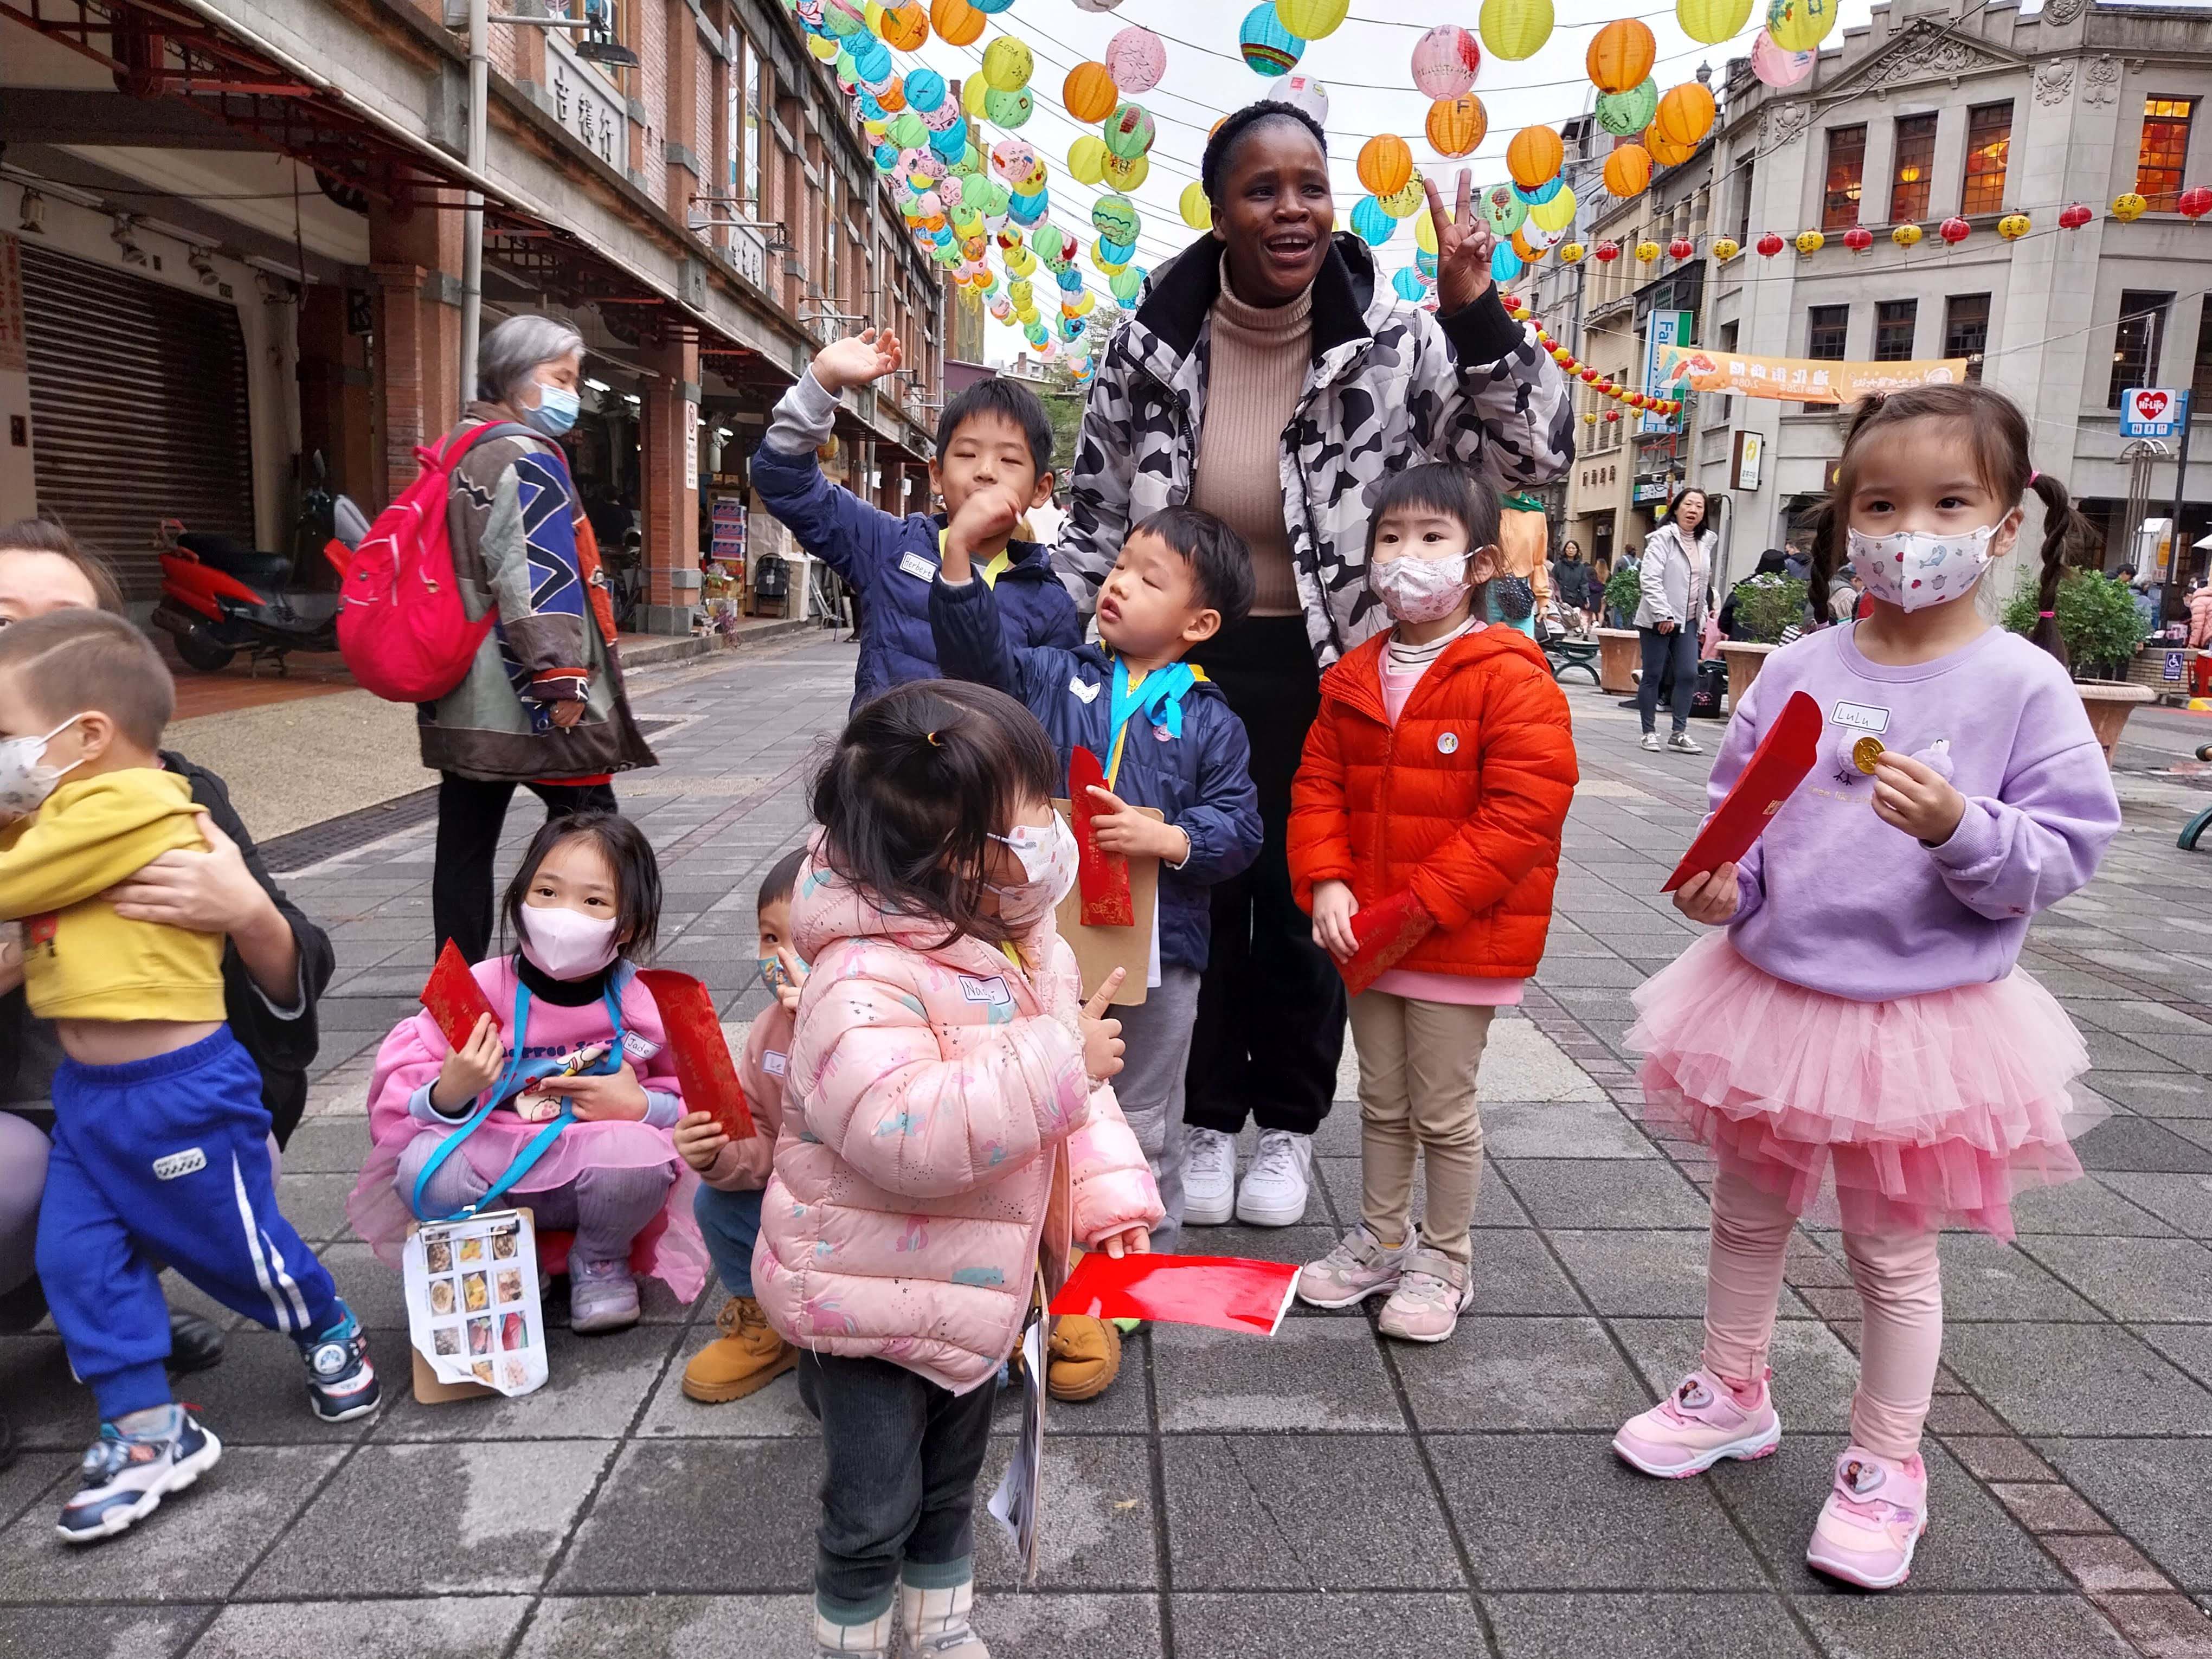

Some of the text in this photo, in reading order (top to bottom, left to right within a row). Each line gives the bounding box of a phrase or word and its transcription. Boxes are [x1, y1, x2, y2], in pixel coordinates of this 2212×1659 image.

[2138, 397, 2165, 414] Hi-Life
[904, 556, 932, 577] Herbert
[1837, 708, 1869, 726] LuLu
[628, 1037, 650, 1055] Jade
